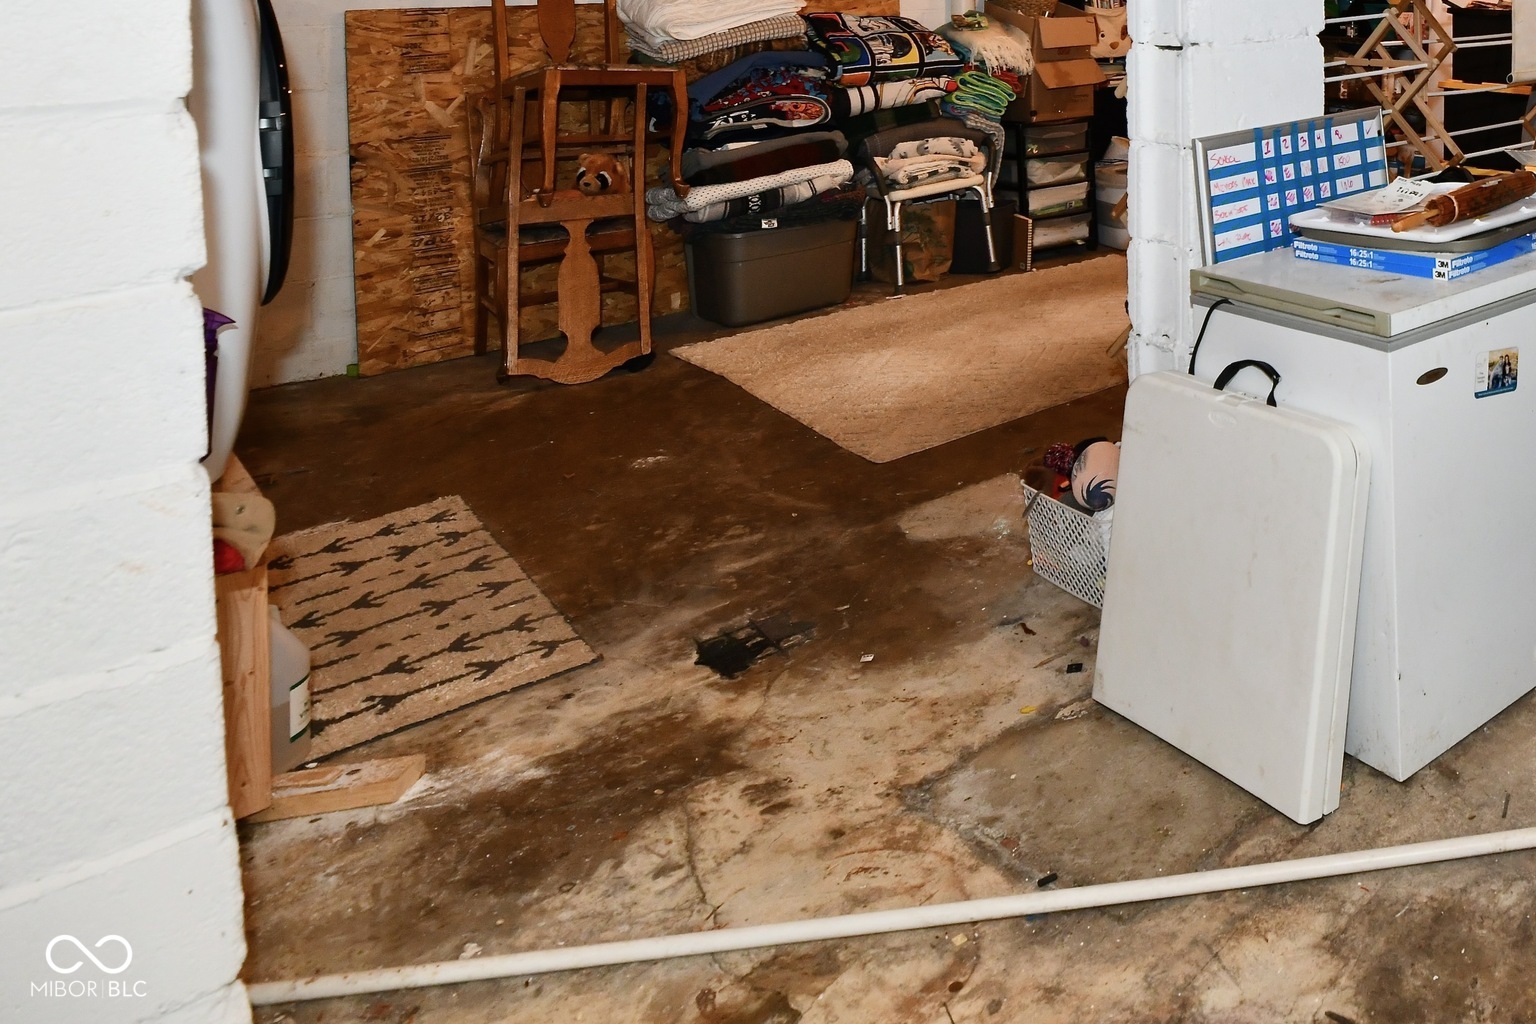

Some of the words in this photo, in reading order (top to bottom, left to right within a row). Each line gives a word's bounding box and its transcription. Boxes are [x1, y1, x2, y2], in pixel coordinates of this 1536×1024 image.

[1264, 141, 1271, 155] 1
[1282, 138, 1289, 149] 2
[1300, 136, 1307, 148] 3
[1316, 134, 1322, 143] 4
[1438, 260, 1449, 268] 3M
[1435, 270, 1446, 278] 3M
